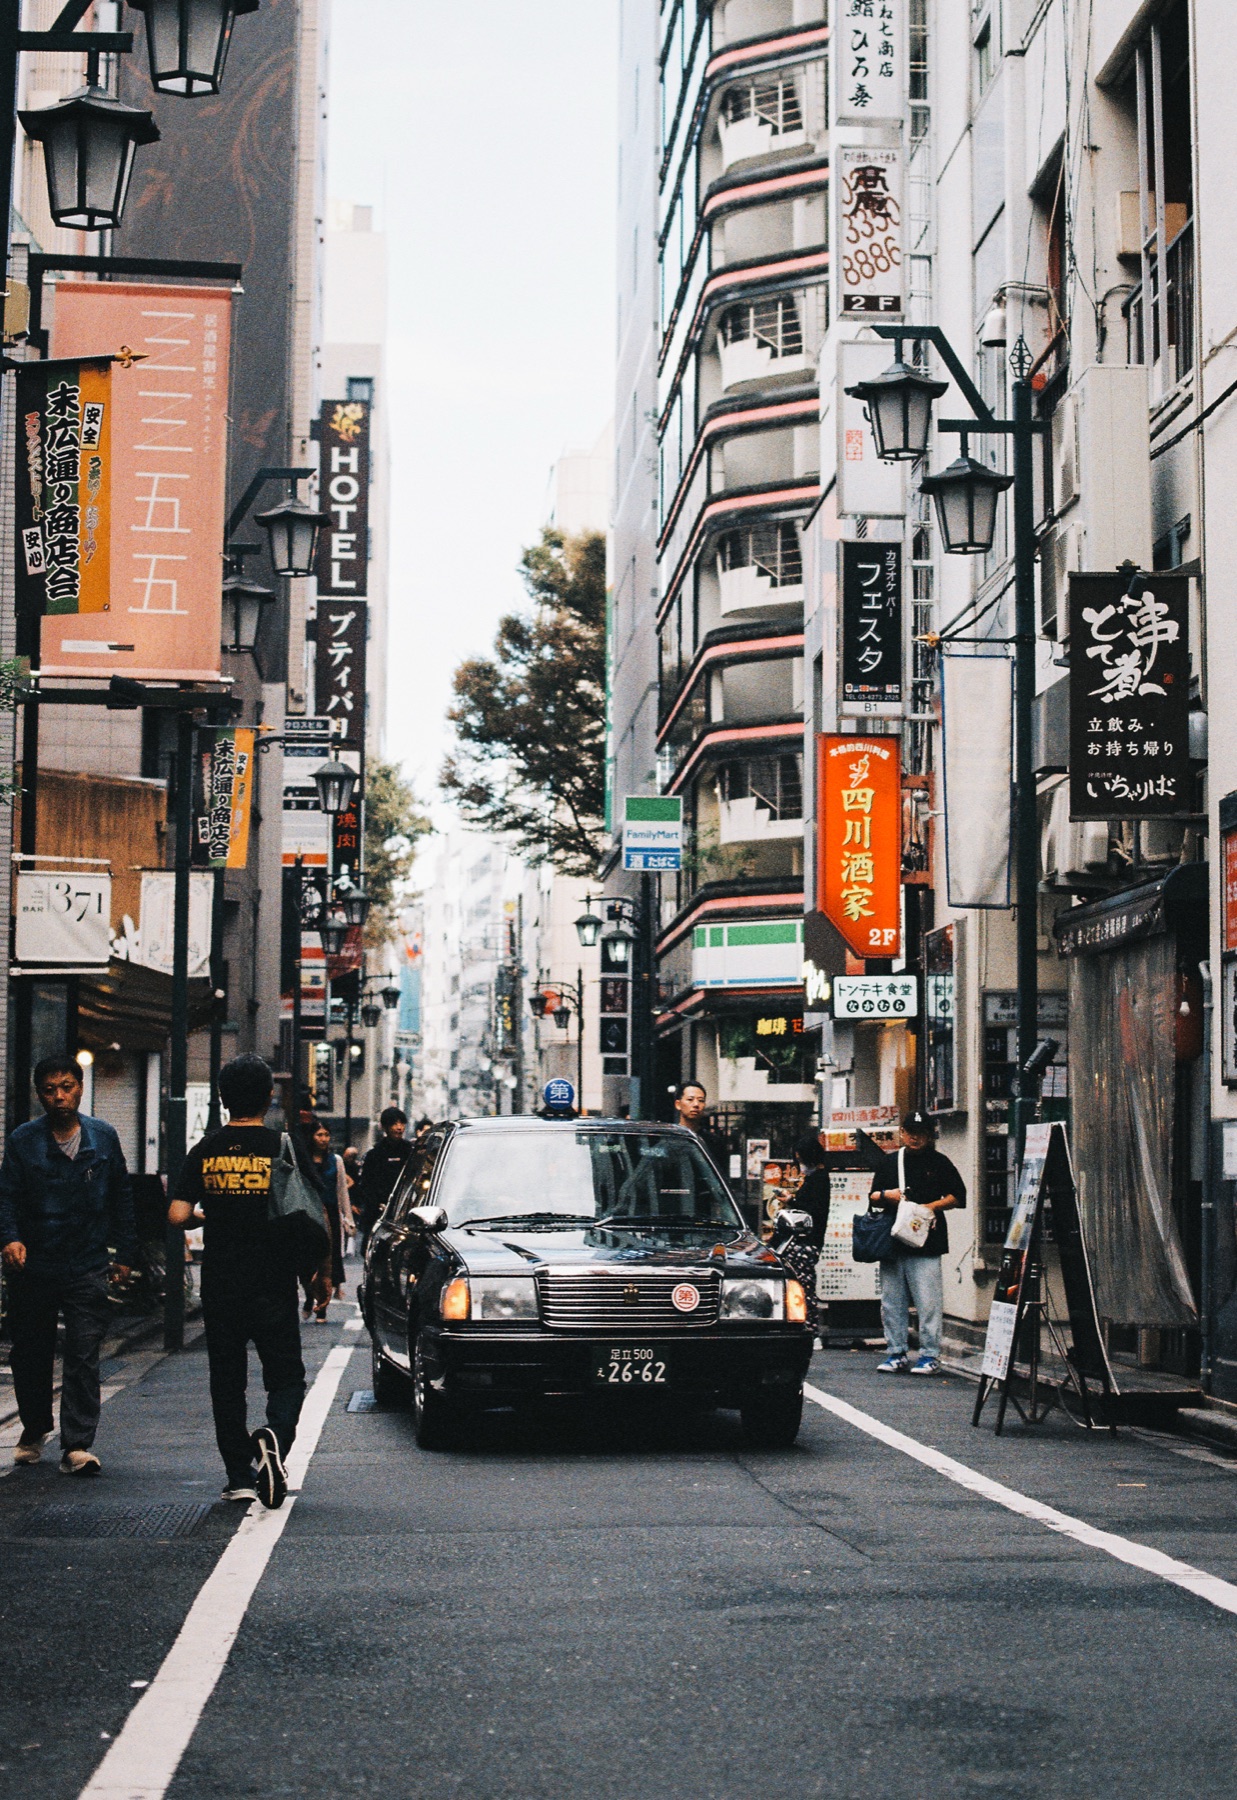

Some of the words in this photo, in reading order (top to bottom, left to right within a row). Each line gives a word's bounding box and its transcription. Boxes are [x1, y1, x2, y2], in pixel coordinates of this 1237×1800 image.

[83, 406, 100, 445] 安全
[44, 380, 80, 600] 末広通り商店会
[329, 446, 360, 589] HOTEL
[25, 531, 42, 568] 安心
[886, 550, 896, 591] カラオケ
[864, 703, 878, 712] B1
[1087, 740, 1174, 756] お持ち帰り
[208, 738, 236, 860] 末広通り商店会
[626, 829, 679, 840] FamilyMart
[840, 787, 875, 922] 四川酒家
[52, 881, 103, 922] 371
[869, 928, 897, 946] 2F
[838, 982, 913, 997] トンテキ食堂
[846, 999, 906, 1013] なかむら
[608, 1361, 666, 1382] 26-62
